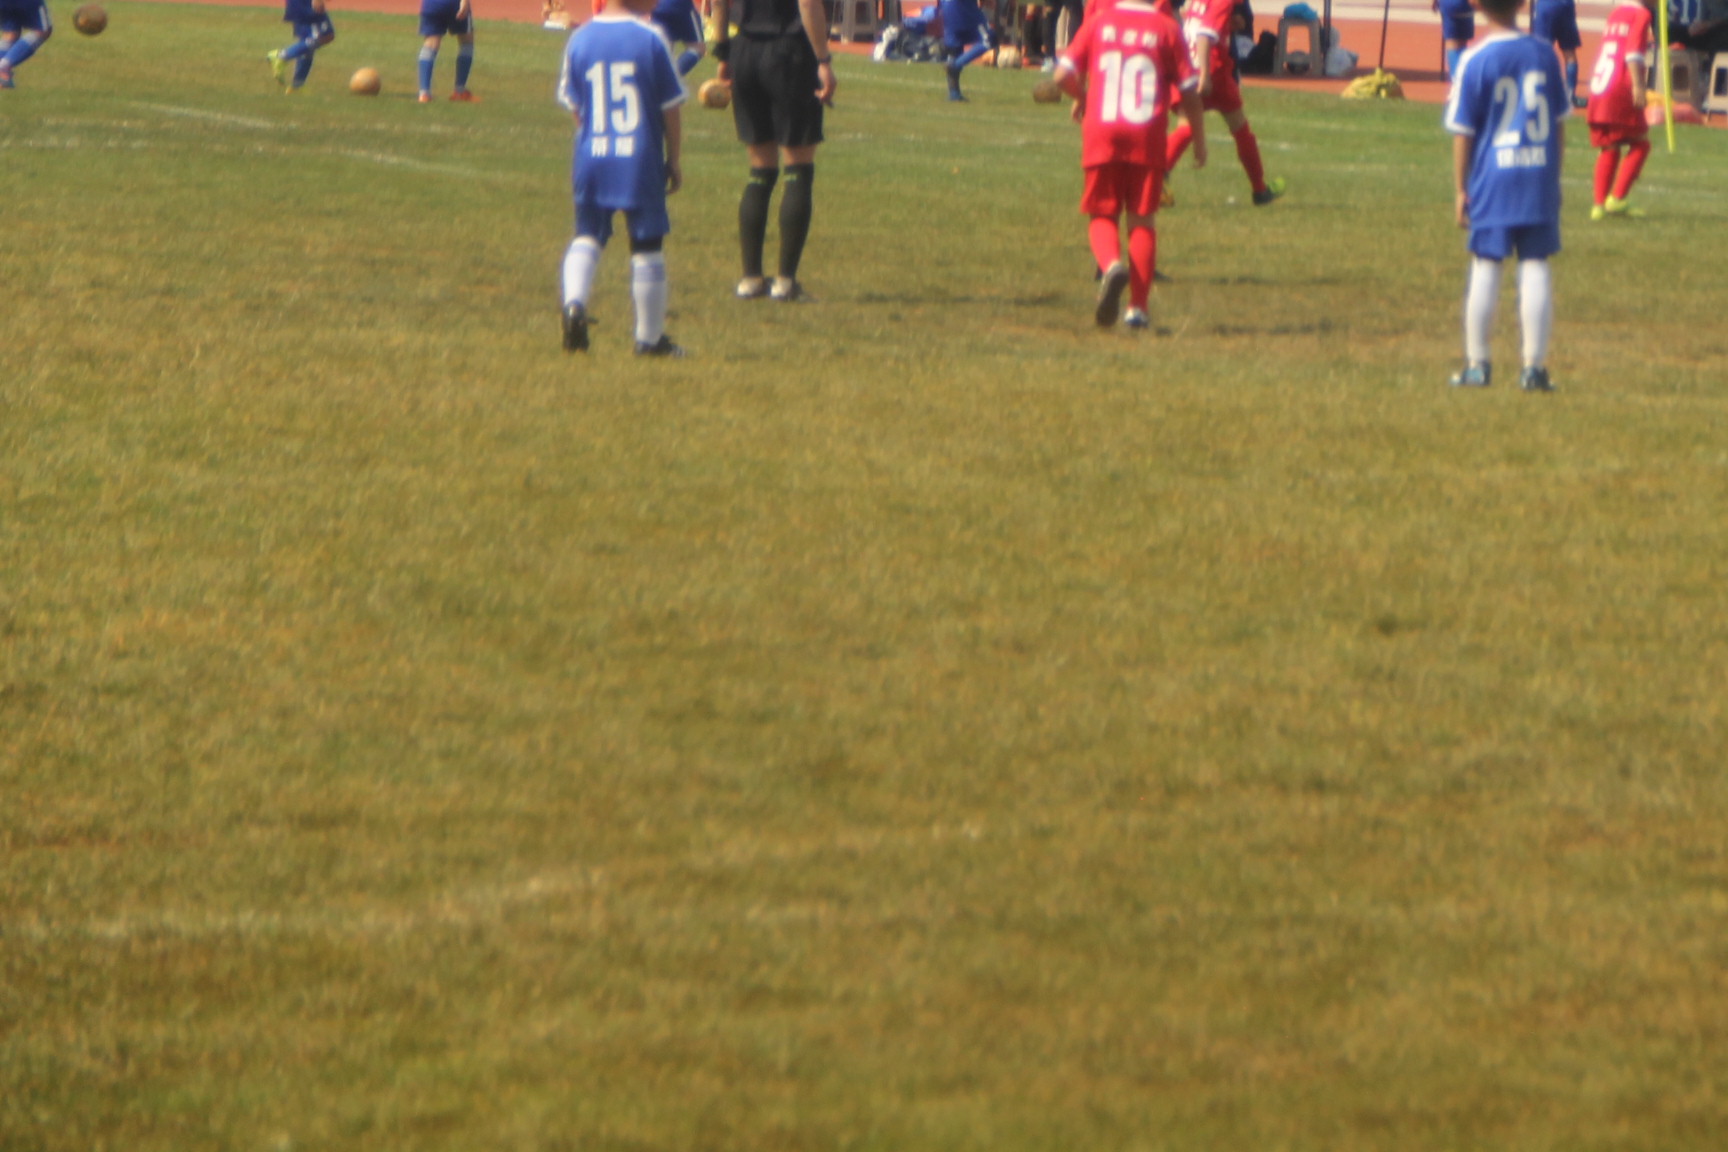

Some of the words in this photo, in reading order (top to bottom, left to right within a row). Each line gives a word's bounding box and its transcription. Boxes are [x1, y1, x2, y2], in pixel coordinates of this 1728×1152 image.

[585, 61, 640, 135] 15
[1099, 50, 1158, 125] 10
[1590, 42, 1618, 95] 5
[1493, 70, 1550, 148] 25
